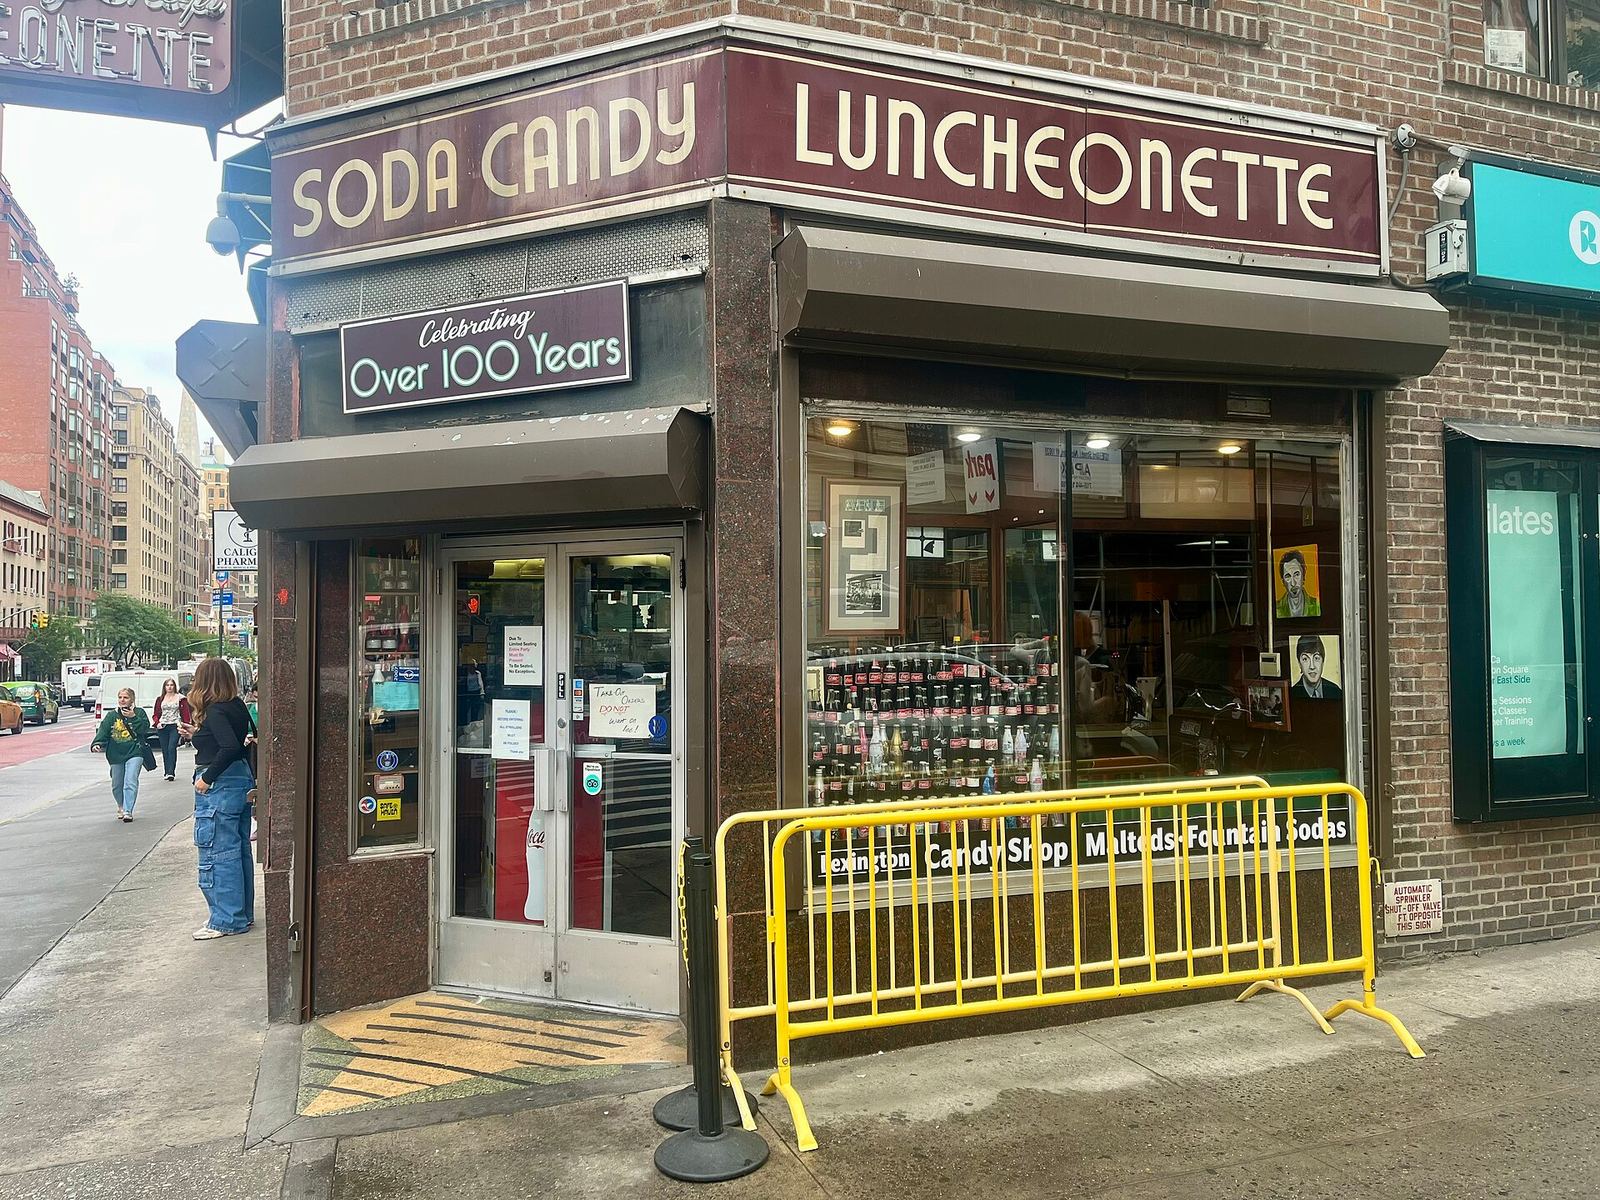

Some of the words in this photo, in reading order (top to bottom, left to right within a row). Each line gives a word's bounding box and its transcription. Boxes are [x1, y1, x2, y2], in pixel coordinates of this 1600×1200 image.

[293, 138, 458, 238] SODA
[481, 82, 697, 198] CANDY
[796, 82, 1334, 229] LUNCHEONETTE
[418, 307, 536, 348] Celebrating
[350, 357, 430, 398] Over
[442, 339, 520, 389] 100
[527, 331, 622, 375] Years
[223, 548, 257, 556] CALIG
[217, 558, 257, 566] PHARM
[67, 666, 96, 675] FedEx
[1502, 665, 1529, 674] Square
[1497, 676, 1512, 684] East
[1514, 675, 1530, 684] Side
[1499, 696, 1532, 705] Sessions
[1498, 706, 1527, 715] Classes
[1504, 716, 1534, 726] Training
[1507, 737, 1526, 746] week
[1286, 816, 1347, 841] Sodas
[925, 840, 1001, 871] Candy
[1008, 837, 1068, 868] Shop
[1394, 885, 1432, 896] AUTOMATIC
[1396, 894, 1431, 904] SPRINKLER
[1422, 901, 1441, 911] VALVE
[1409, 910, 1441, 921] OPPOSITE
[1397, 922, 1413, 931] THIS
[1415, 920, 1431, 930] SIGN
